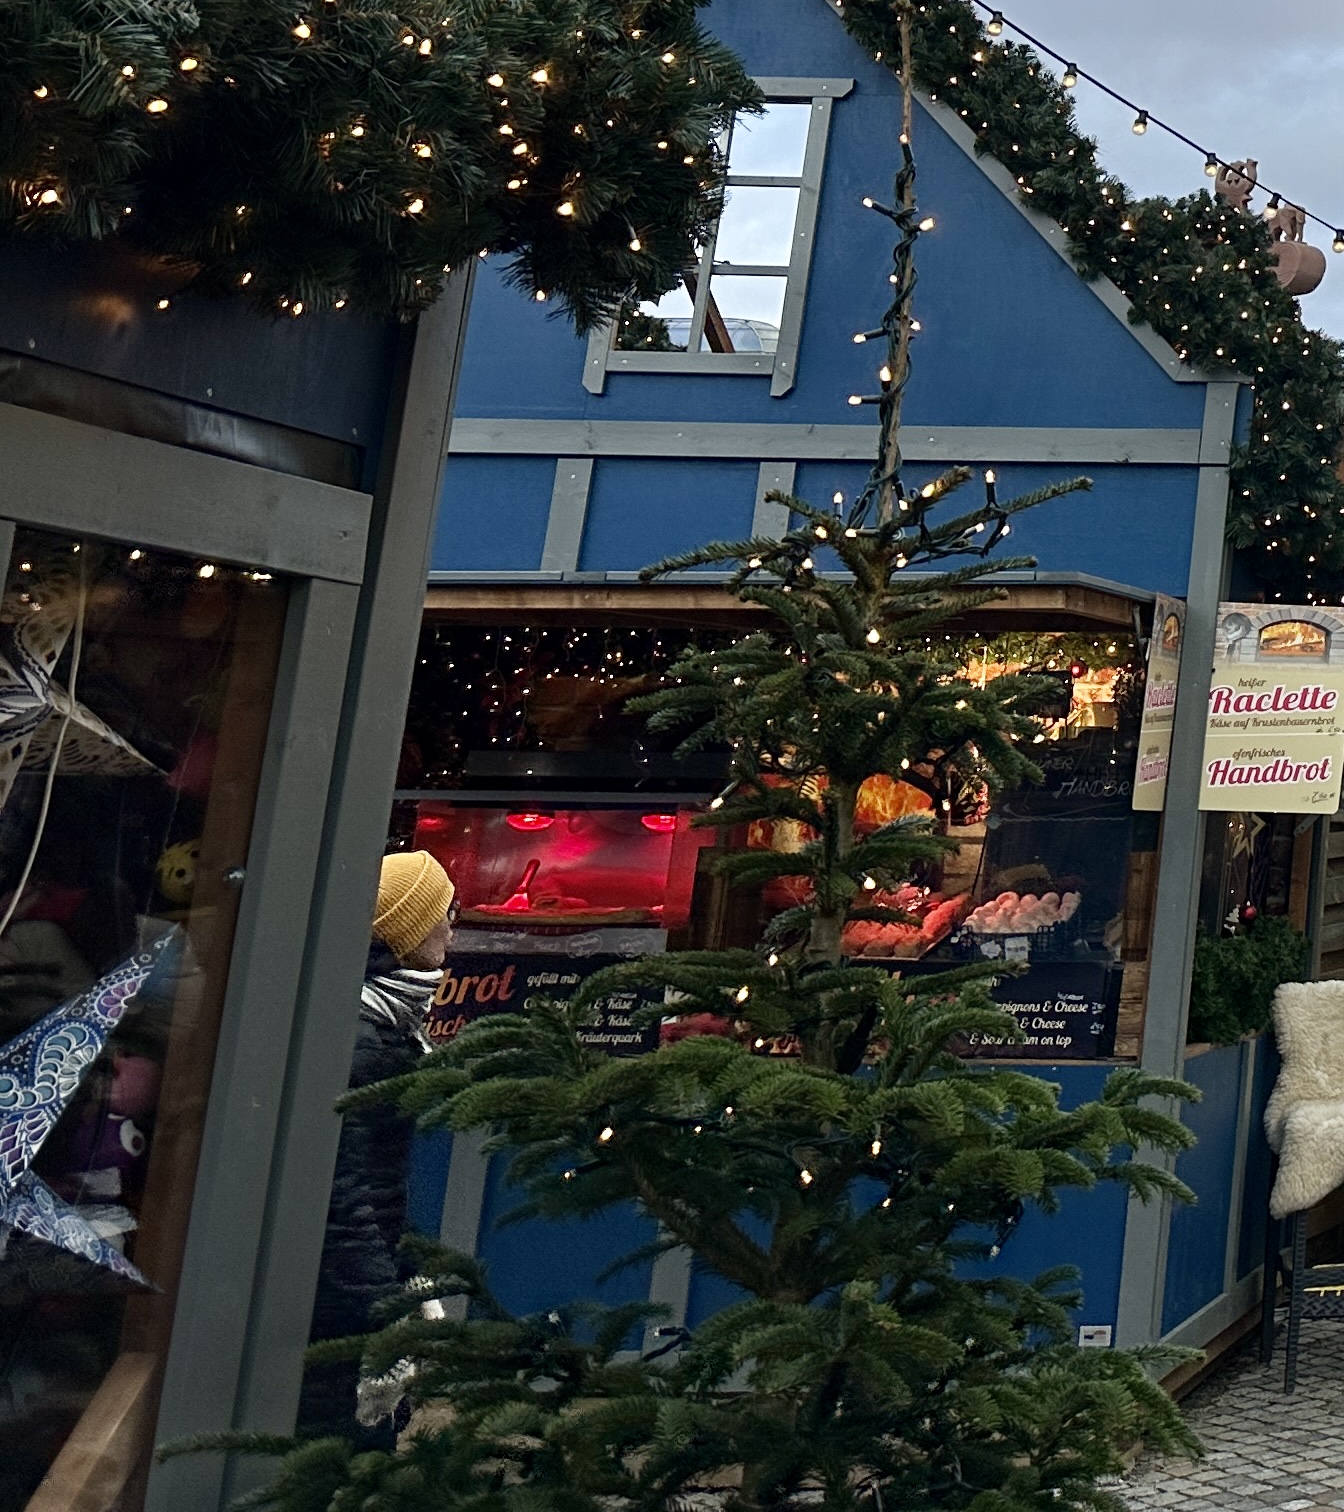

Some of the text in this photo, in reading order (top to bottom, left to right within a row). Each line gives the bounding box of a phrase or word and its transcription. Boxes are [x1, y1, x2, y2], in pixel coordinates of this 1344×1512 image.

[1238, 677, 1267, 689] heißer
[1208, 686, 1337, 714] Raclette
[1210, 716, 1336, 730] Käse auf Krustenbauernbrot
[1232, 747, 1286, 761] ofenfrisches
[1208, 758, 1331, 786] Handbrot
[433, 965, 516, 1006] brot
[593, 995, 606, 1009] &
[606, 995, 634, 1010] Käse
[1042, 999, 1052, 1013] &
[1054, 1000, 1089, 1013] Cheese
[594, 1015, 606, 1027] &
[1019, 1016, 1067, 1029] & Cheese
[969, 1034, 980, 1045] &
[1041, 1036, 1054, 1046] on
[1055, 1034, 1072, 1049] top
